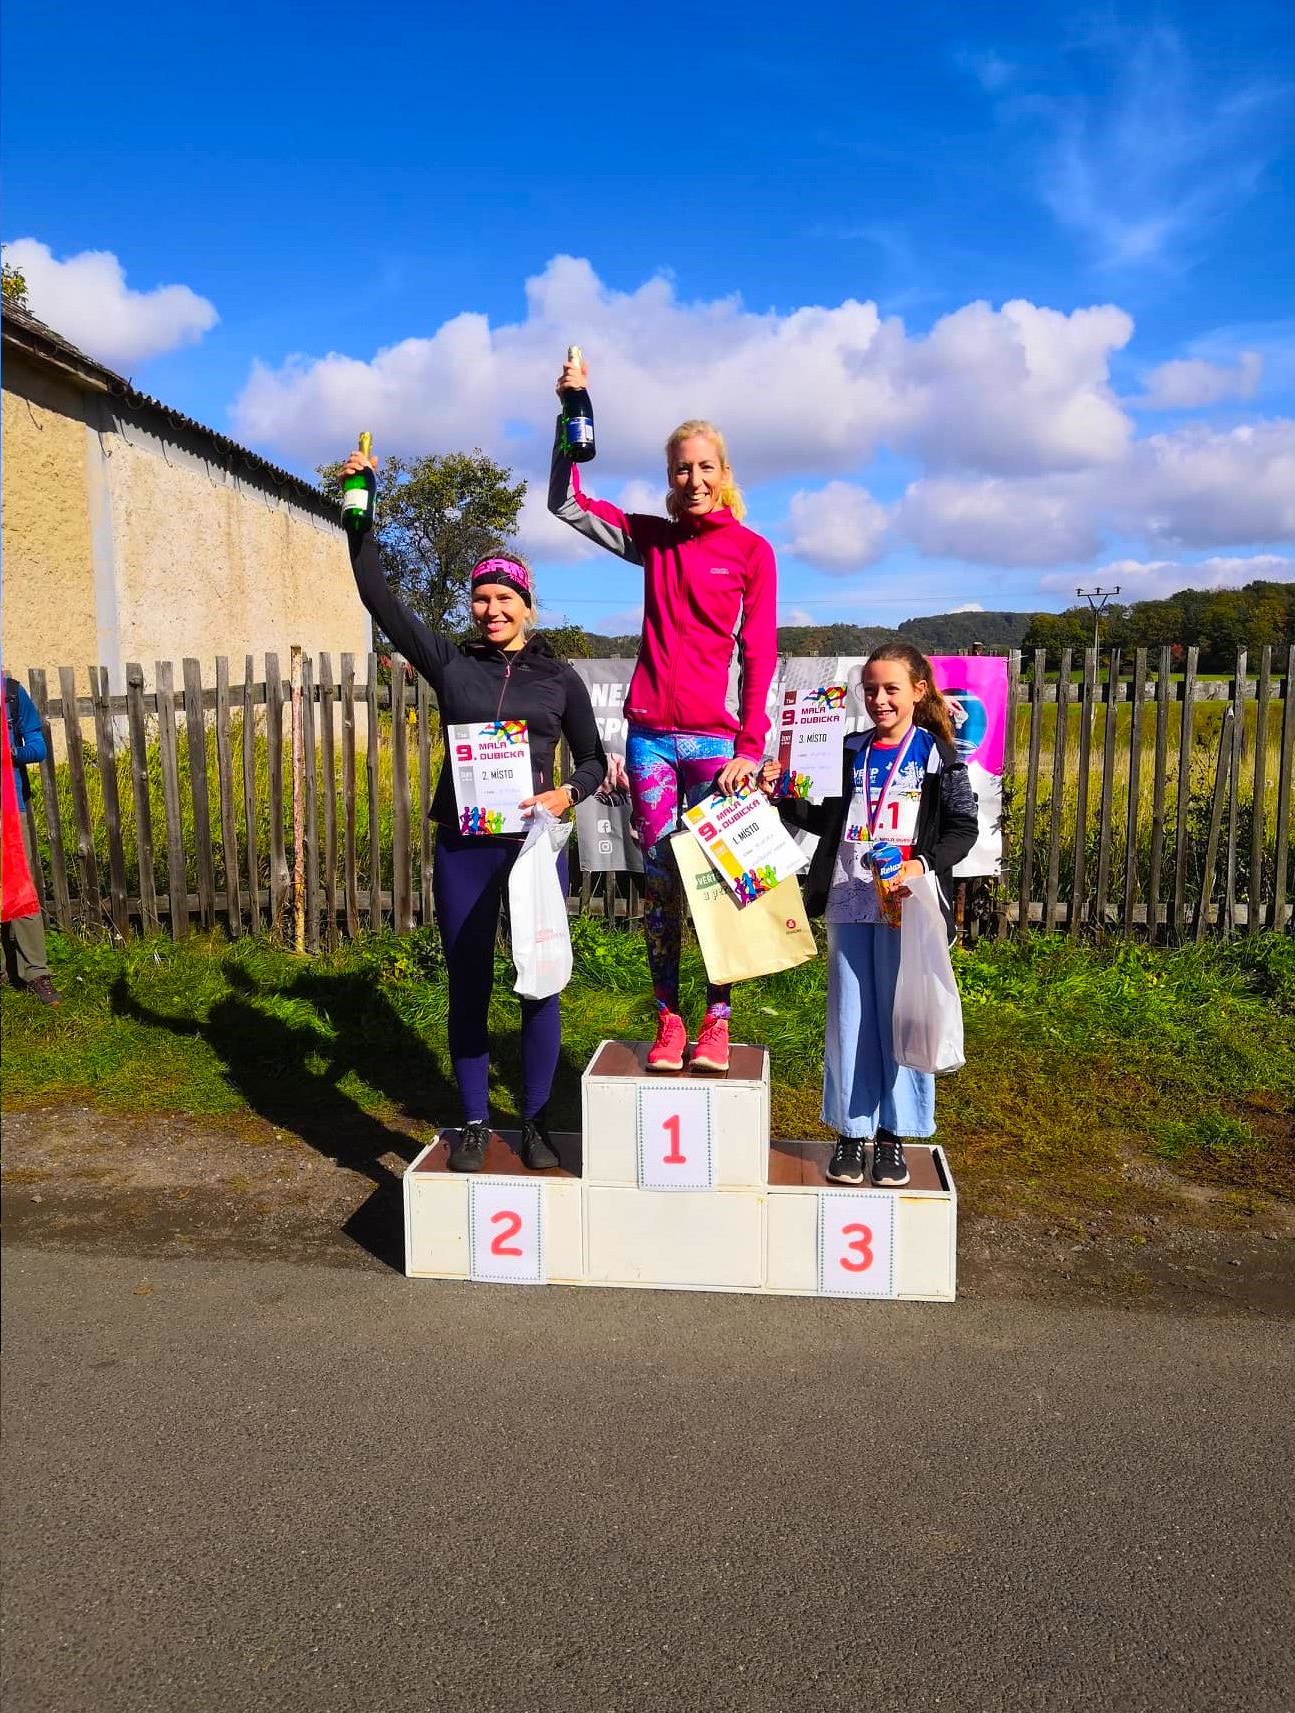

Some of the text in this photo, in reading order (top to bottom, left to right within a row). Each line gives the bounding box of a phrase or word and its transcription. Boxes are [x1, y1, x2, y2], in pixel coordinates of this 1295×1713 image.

[782, 709, 798, 726] 9.
[799, 732, 827, 744] 3. MÍSTO
[456, 744, 478, 761] 9.
[482, 771, 489, 781] 2.
[491, 768, 514, 780] MÍSTO
[698, 821, 722, 842] 9.
[738, 822, 760, 842] MÍSTO
[880, 863, 902, 876] Relax
[662, 1115, 686, 1164] 1
[490, 1210, 523, 1256] 2
[840, 1223, 873, 1272] 3
